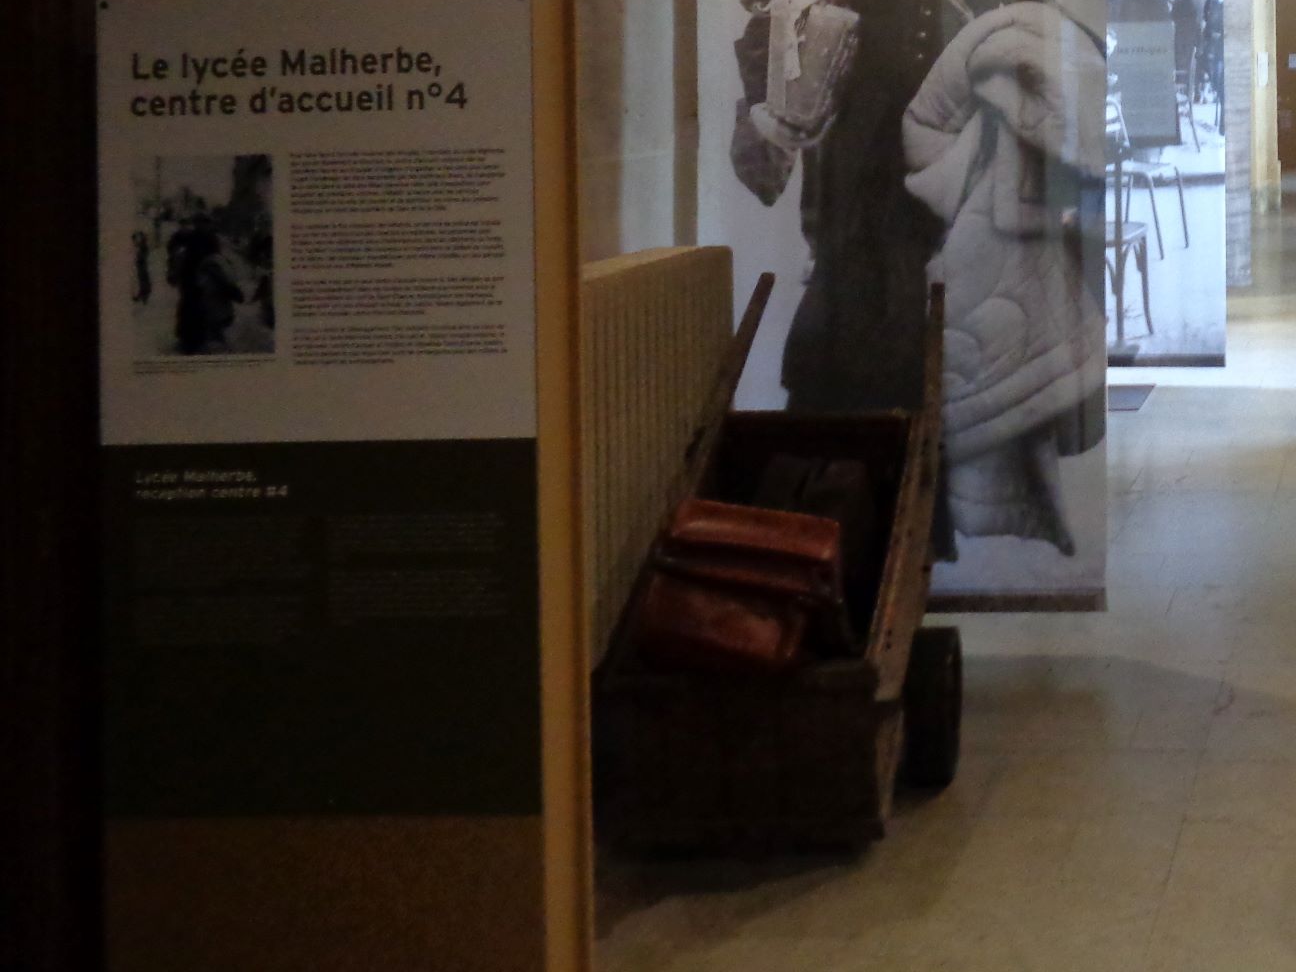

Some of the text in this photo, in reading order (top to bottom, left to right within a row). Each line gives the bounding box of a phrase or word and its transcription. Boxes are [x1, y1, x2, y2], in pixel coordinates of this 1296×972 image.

[131, 45, 442, 85] Le lycée Malherbe,
[130, 88, 237, 116] centre
[248, 82, 394, 114] d'accueil
[211, 486, 261, 499] centre
[265, 484, 288, 497] #4
